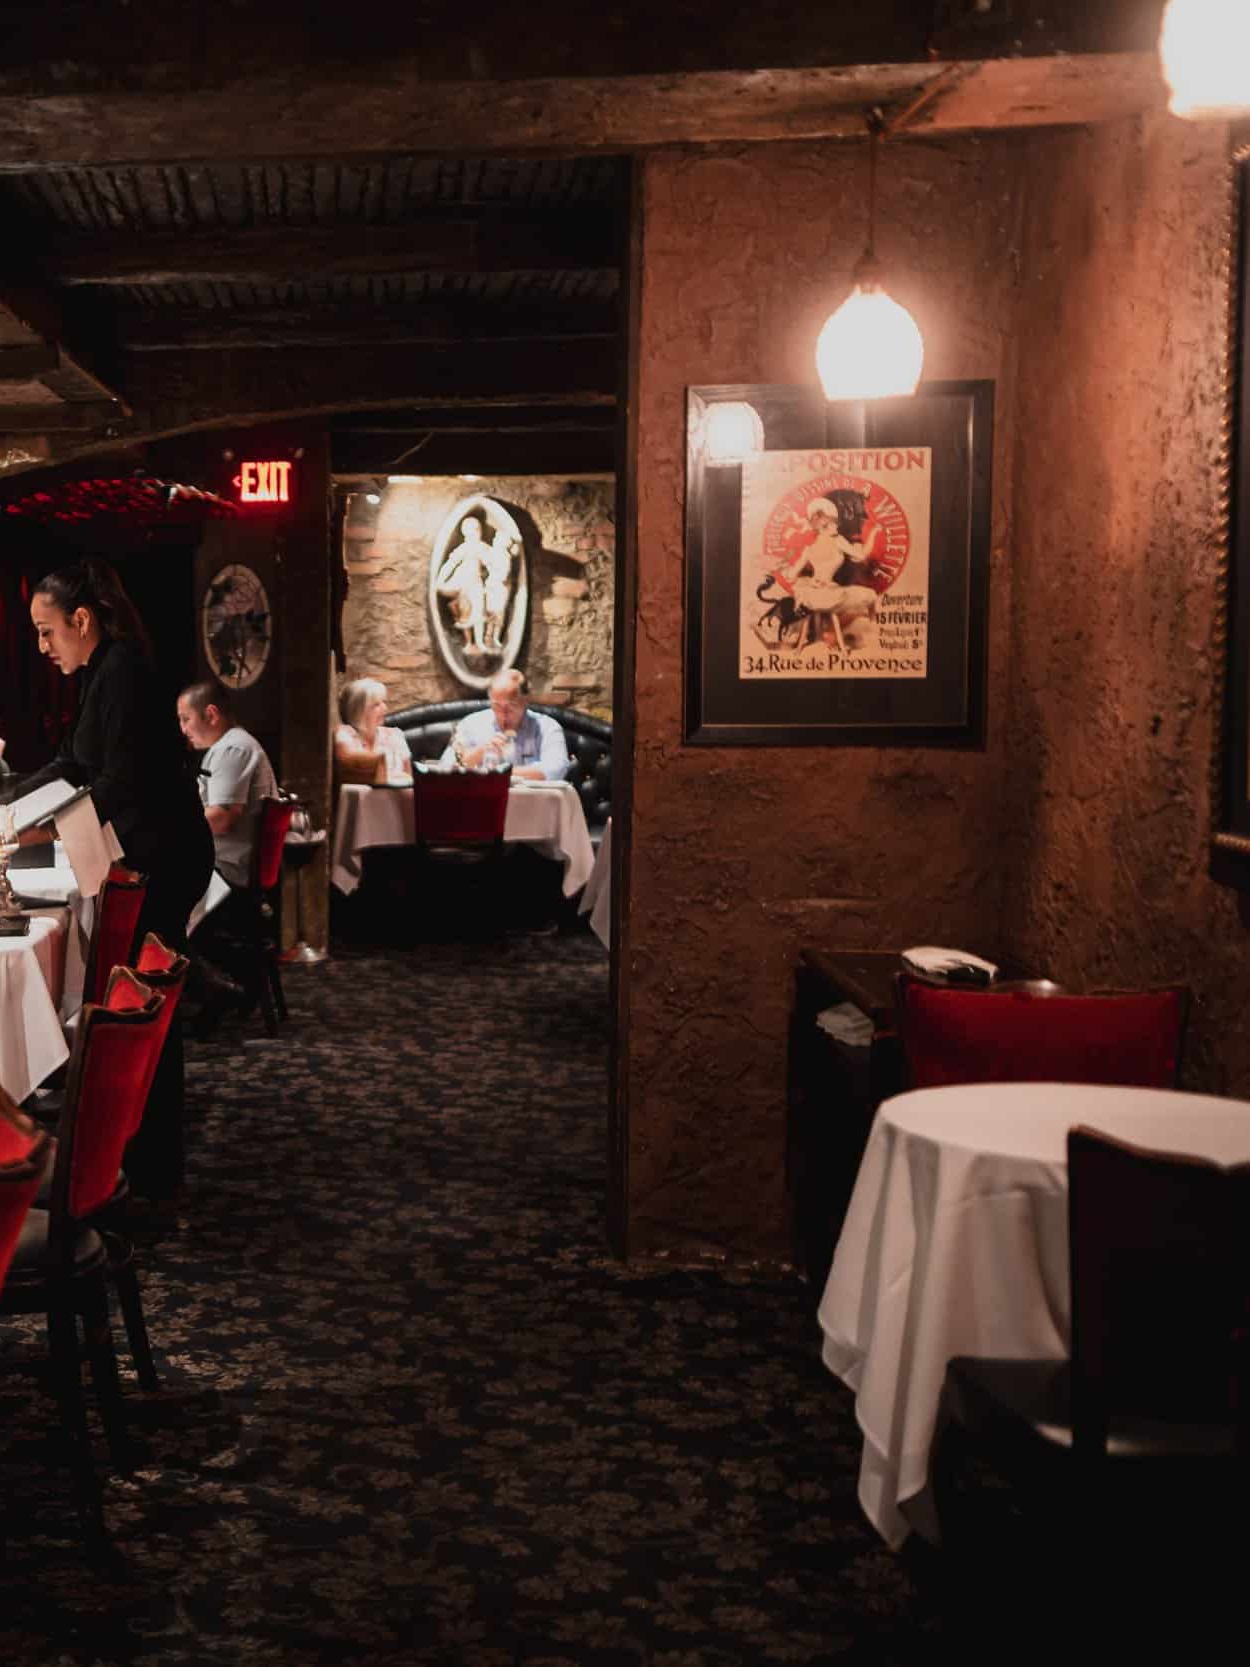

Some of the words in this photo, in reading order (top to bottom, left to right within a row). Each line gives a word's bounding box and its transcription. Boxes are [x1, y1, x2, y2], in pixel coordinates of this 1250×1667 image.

[241, 461, 291, 502] EXIT
[806, 656, 824, 671] de
[828, 653, 923, 673] Provence
